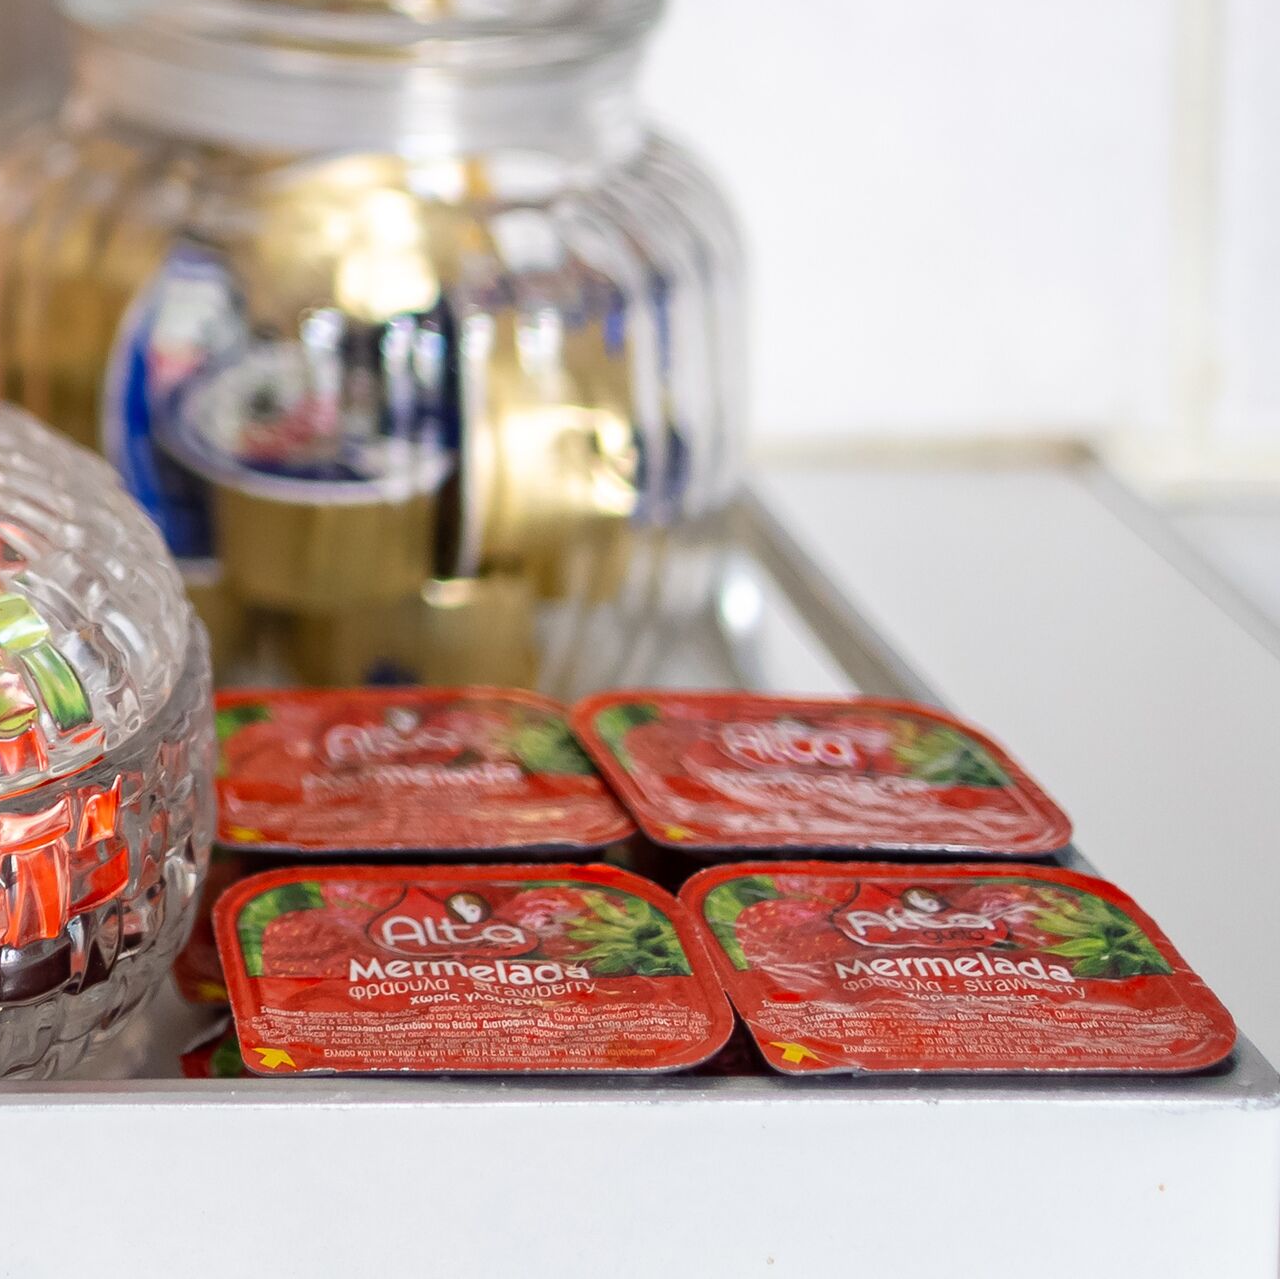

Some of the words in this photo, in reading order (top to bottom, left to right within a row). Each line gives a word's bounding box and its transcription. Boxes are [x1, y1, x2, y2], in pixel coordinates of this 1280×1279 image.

[382, 915, 526, 946] Alta
[349, 958, 590, 985] Mermelada
[834, 952, 1075, 983] Mermelada
[473, 980, 596, 999] strawberry
